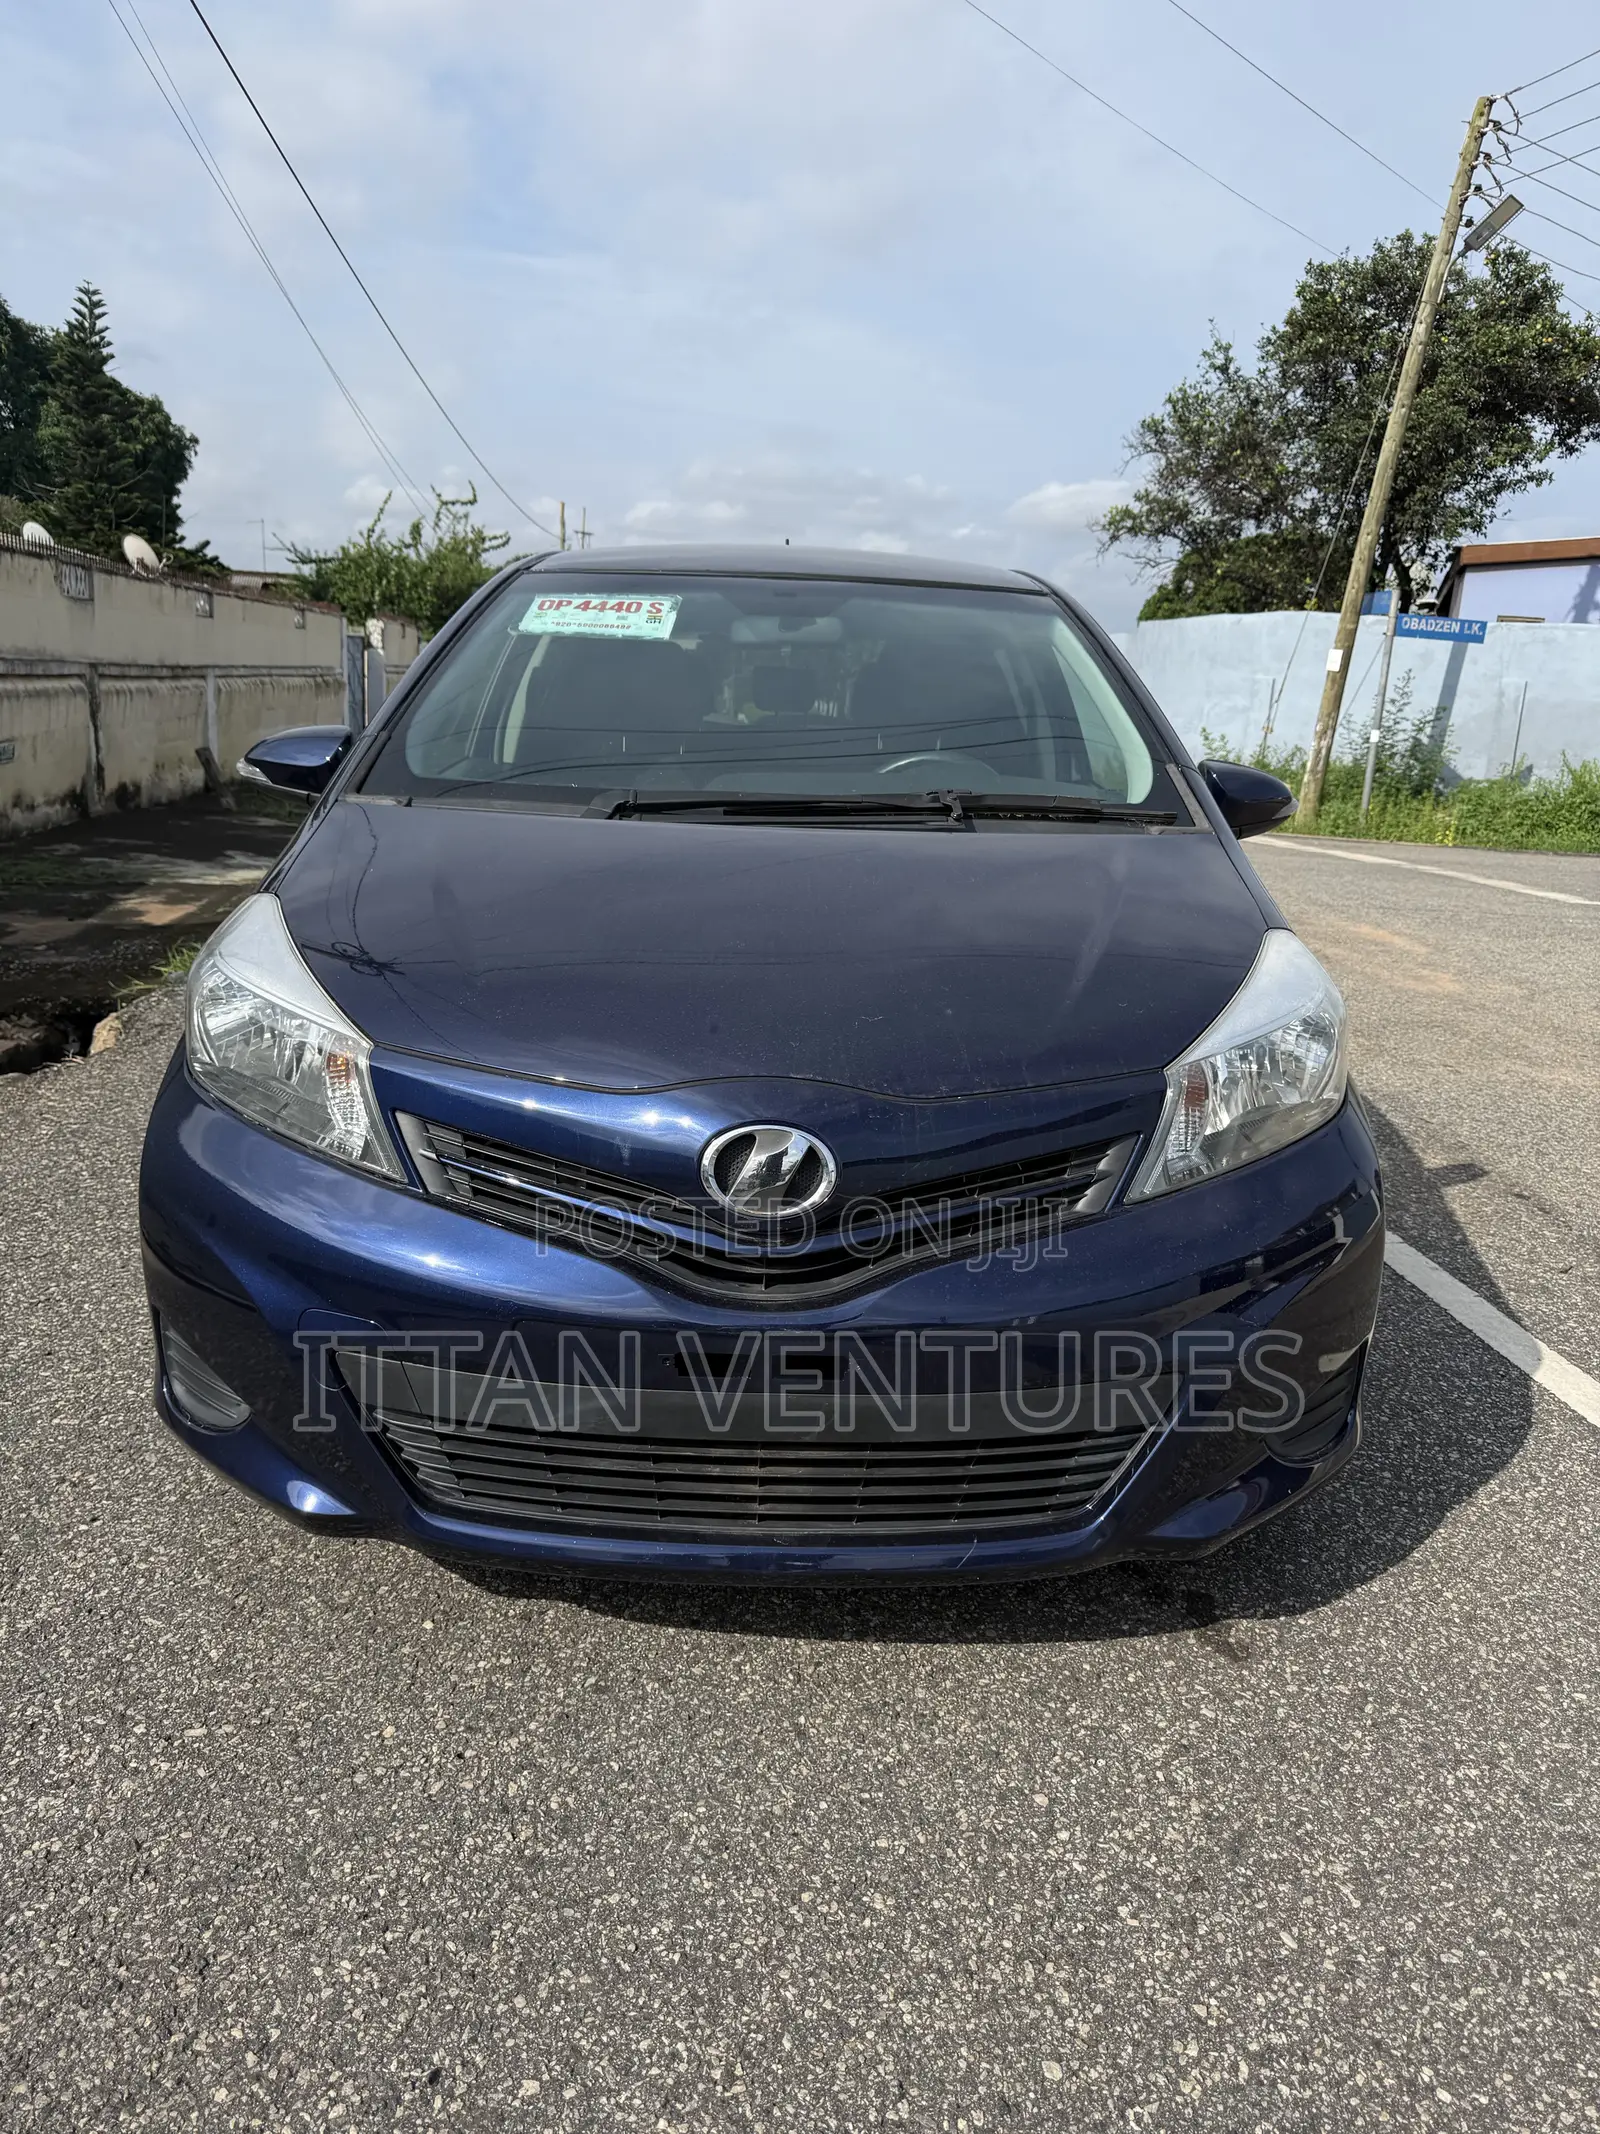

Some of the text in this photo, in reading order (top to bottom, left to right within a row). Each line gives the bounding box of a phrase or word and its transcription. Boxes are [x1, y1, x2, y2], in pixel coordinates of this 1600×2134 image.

[574, 600, 643, 613] 4440
[646, 601, 665, 614] S
[1401, 617, 1460, 633] OBADZEN
